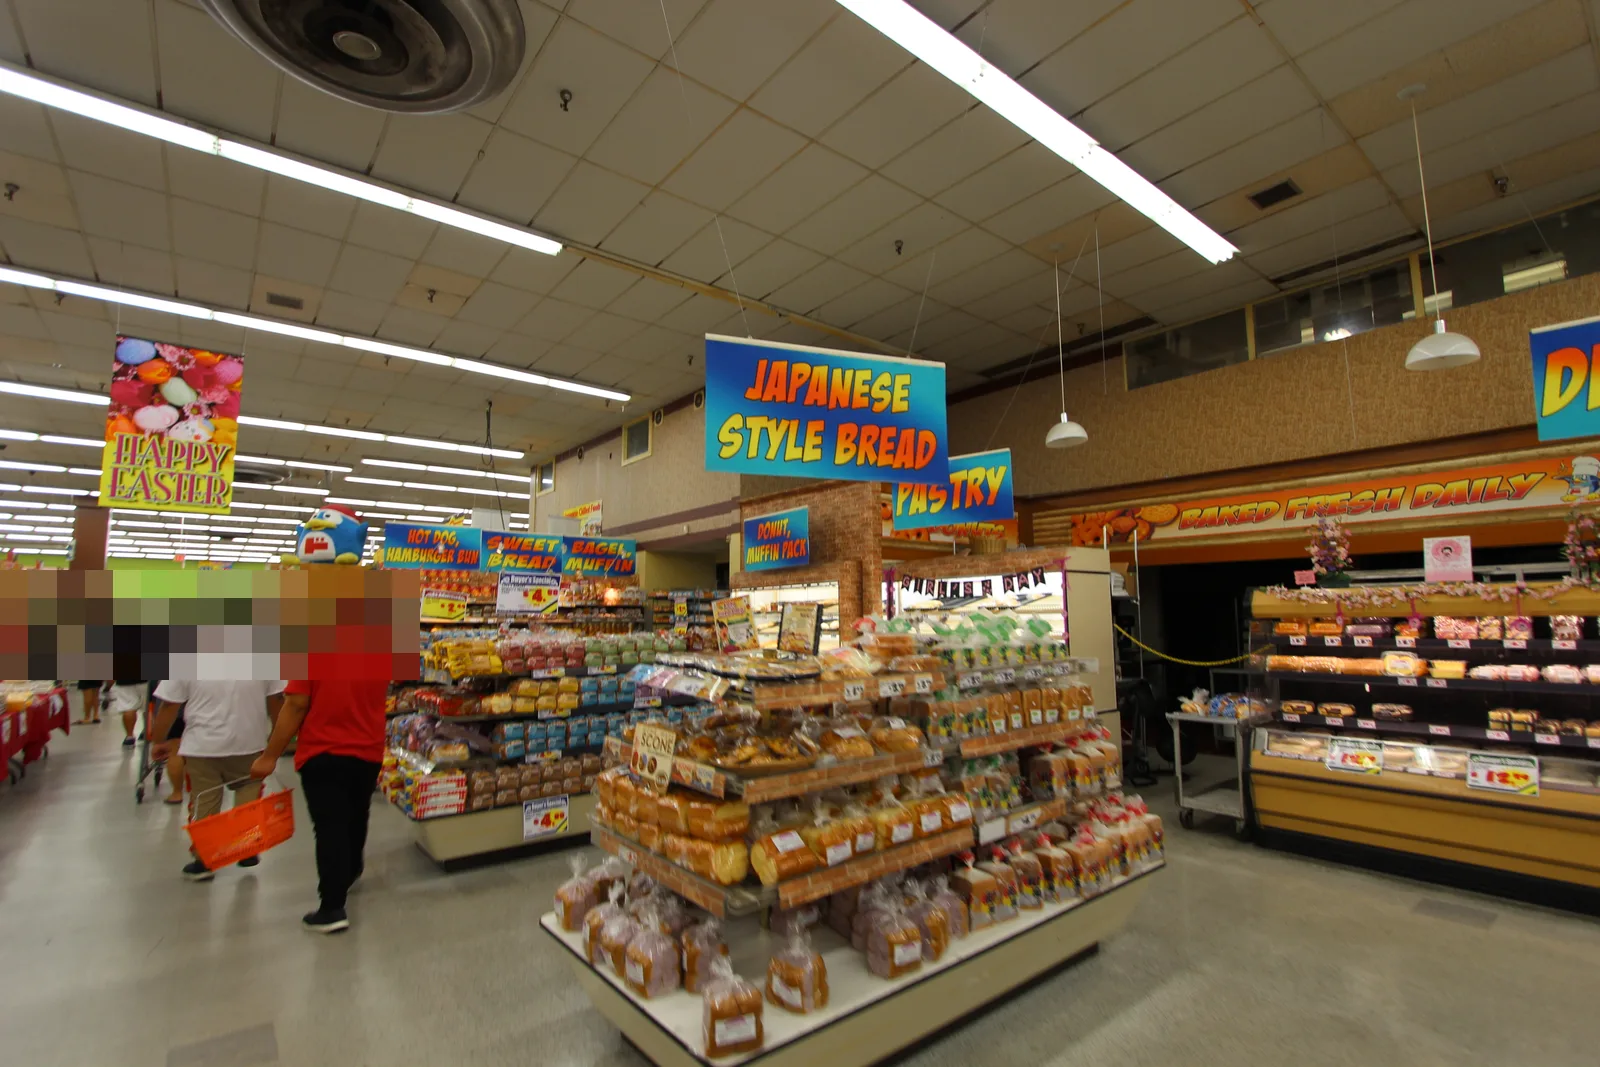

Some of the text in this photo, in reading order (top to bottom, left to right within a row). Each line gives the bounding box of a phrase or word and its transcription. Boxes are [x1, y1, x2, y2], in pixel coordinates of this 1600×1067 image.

[744, 358, 911, 414] JAPANESE
[114, 432, 231, 474] HAPPY
[717, 412, 937, 471] STYLE BREAD
[108, 466, 227, 508] EASTER
[895, 465, 1007, 517] PASTRY
[1178, 472, 1547, 530] BAKED FRESH DAILY
[407, 527, 459, 548] HOT DOG,
[757, 517, 791, 540] DONUT,
[386, 546, 479, 565] HAMBURGER BUN
[487, 535, 559, 552] SWEET
[746, 538, 806, 565] MUFFIN PACK
[487, 553, 556, 569] BREAD
[564, 557, 633, 572] MUFFIN
[901, 567, 1043, 597] GIRL'S DAY
[641, 732, 673, 755] SCONE
